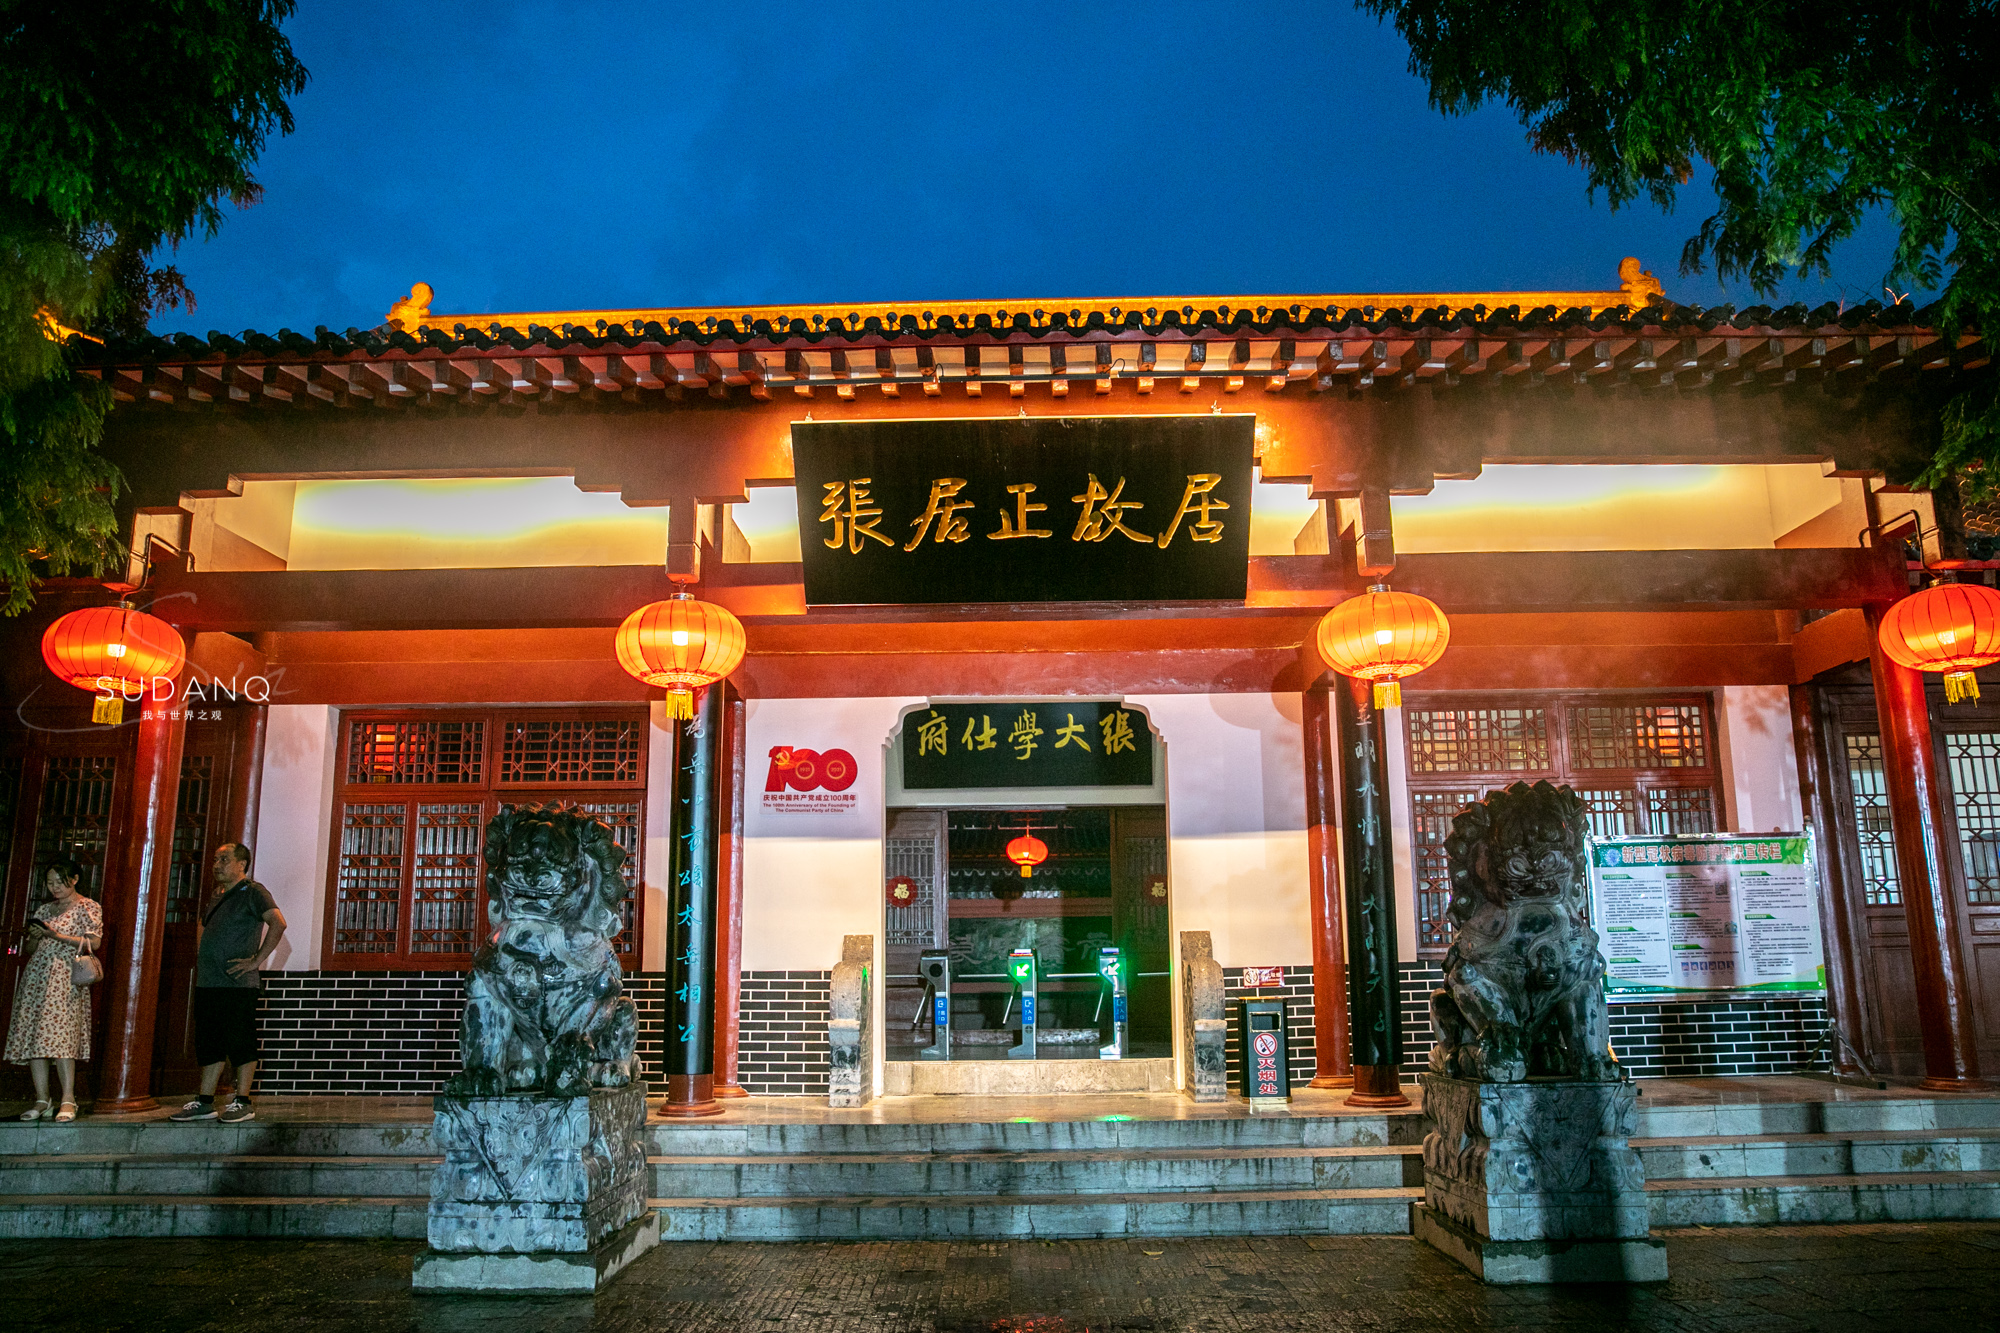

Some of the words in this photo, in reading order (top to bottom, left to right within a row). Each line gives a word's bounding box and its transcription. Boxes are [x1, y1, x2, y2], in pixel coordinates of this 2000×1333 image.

[819, 473, 1230, 554] 張居正故居
[1621, 843, 1782, 864] 新型冠状病毒防护知识宣传栏
[893, 883, 910, 899] 福
[1258, 1057, 1278, 1095] 灭烟处
